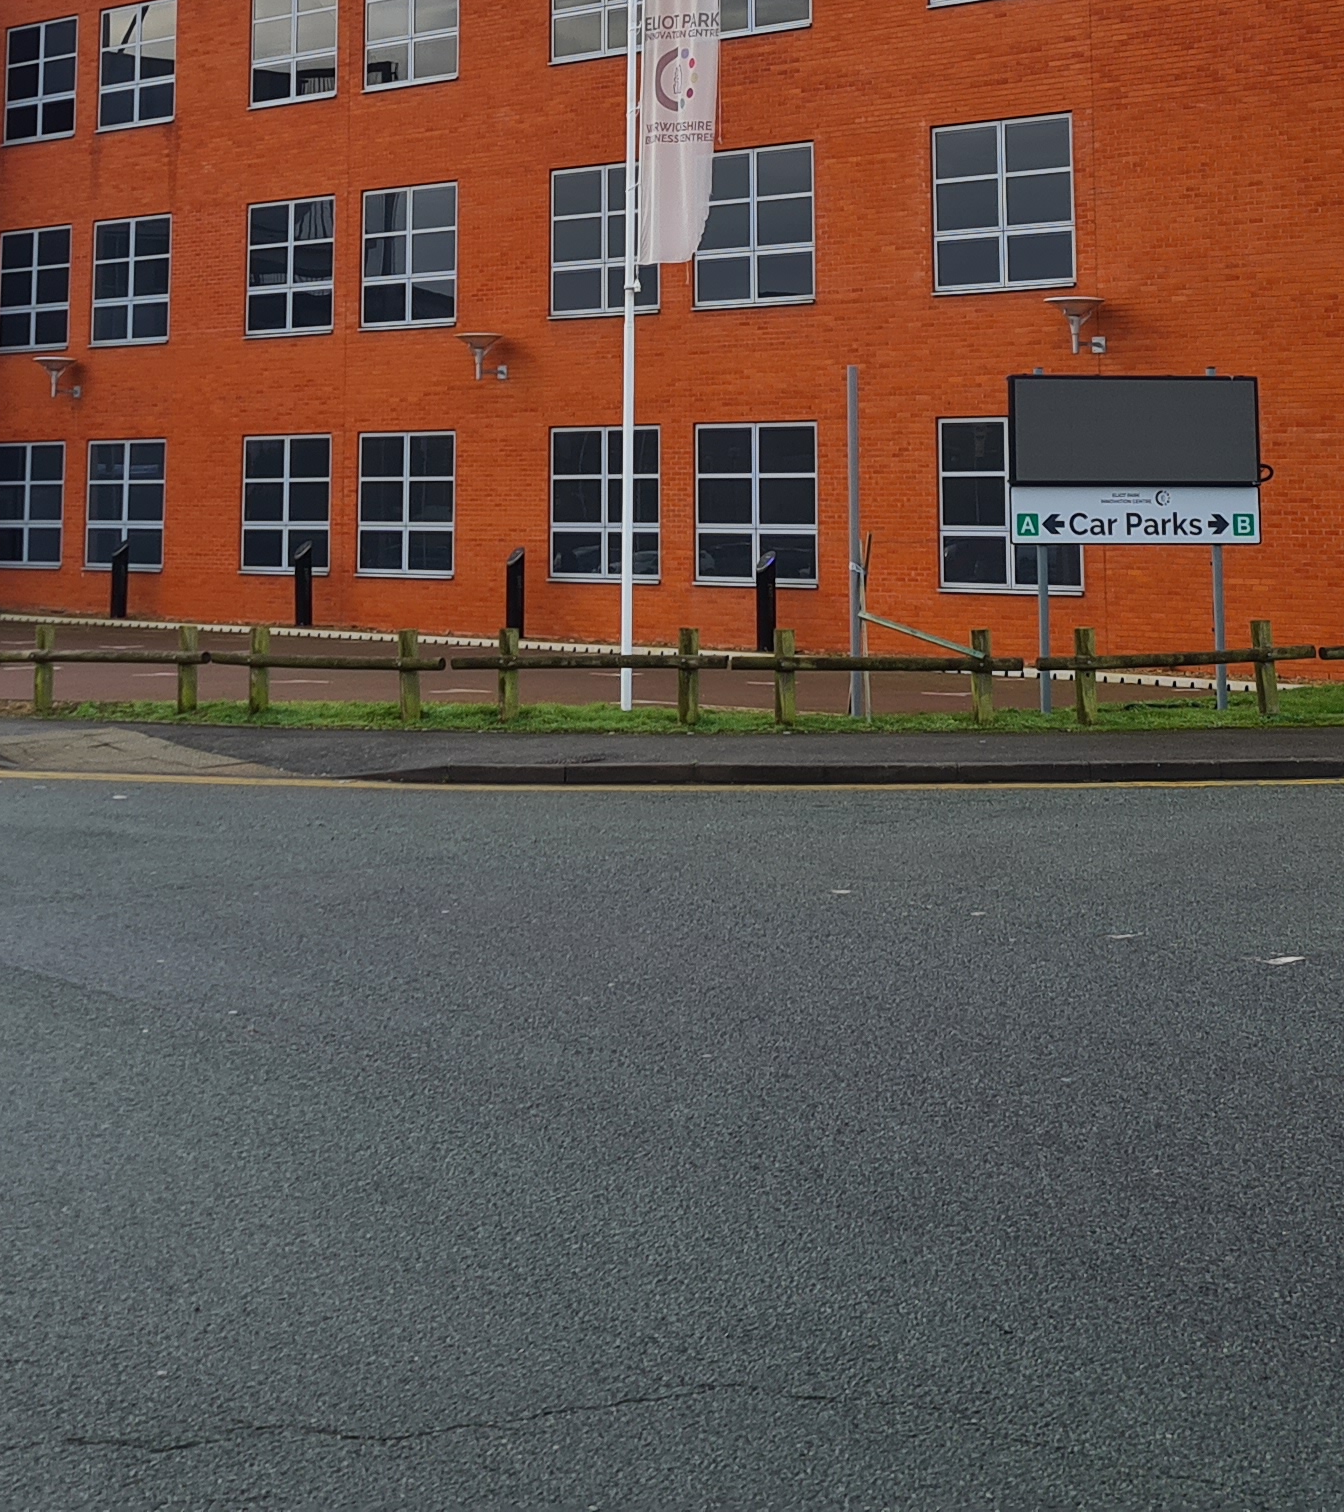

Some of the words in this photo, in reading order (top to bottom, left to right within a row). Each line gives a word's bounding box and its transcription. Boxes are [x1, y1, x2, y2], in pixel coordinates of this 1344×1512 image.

[645, 14, 679, 31] ELIOT
[682, 11, 719, 28] PARK
[1020, 516, 1036, 533] A
[1069, 513, 1118, 536] Car
[1126, 512, 1203, 536] Parks
[1237, 516, 1251, 533] B
